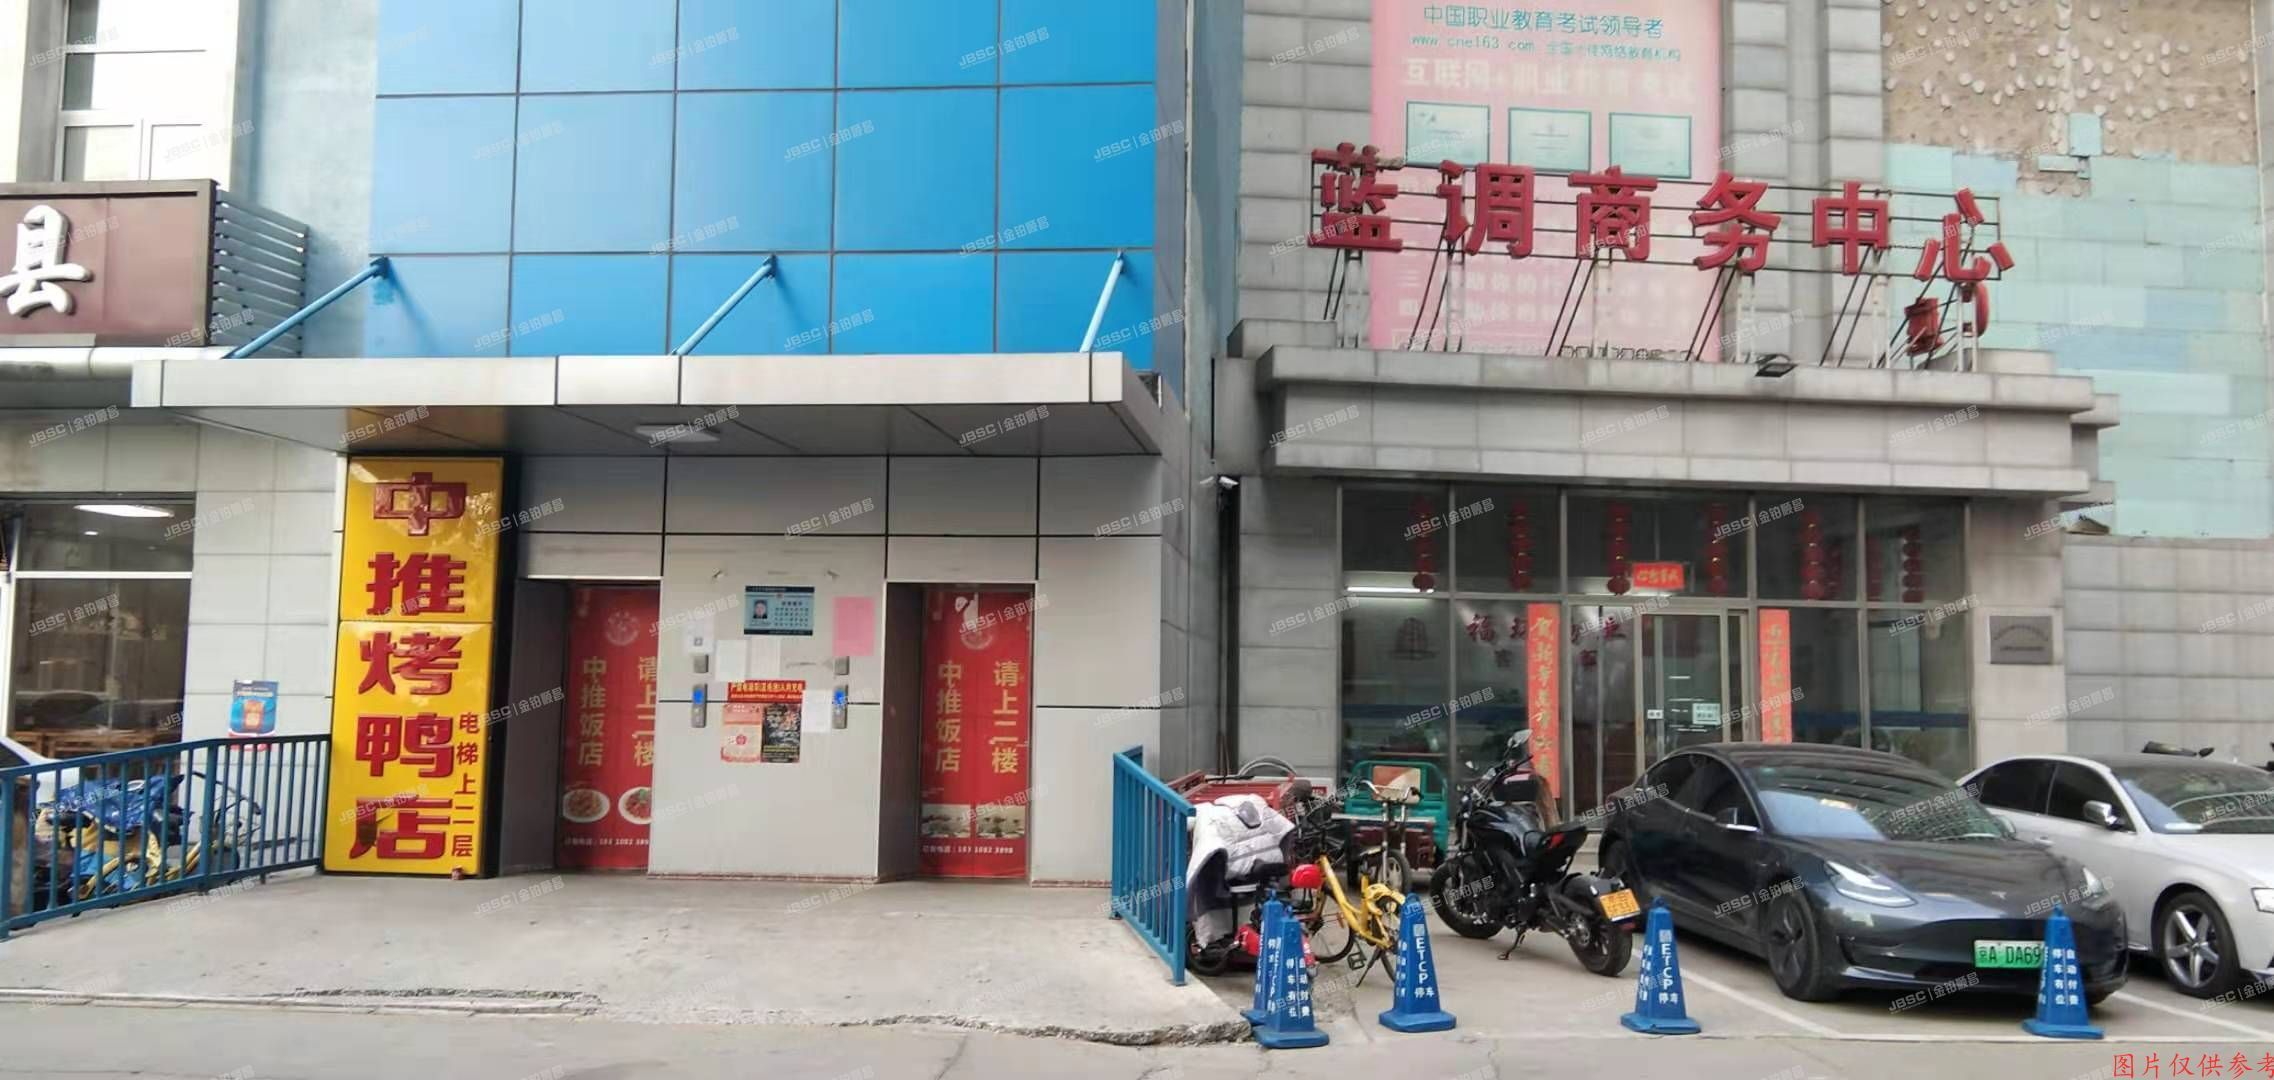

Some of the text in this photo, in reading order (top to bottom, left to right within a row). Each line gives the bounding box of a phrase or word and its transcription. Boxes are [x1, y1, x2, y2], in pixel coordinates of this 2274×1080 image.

[1423, 4, 1665, 40] 中国职业教育考试领导者
[0, 205, 92, 317] 县
[1307, 142, 2016, 283] 蓝调商务中心
[349, 472, 467, 860] 中推烤鸭店
[577, 655, 608, 767] 中推饭店
[632, 656, 657, 767] 请上二楼
[935, 659, 962, 773] 中推饭店
[991, 660, 1021, 774] 请上二楼
[451, 711, 481, 858] 电梯上二层
[1415, 937, 1429, 985] ETCP
[1660, 943, 1674, 991] ETCP
